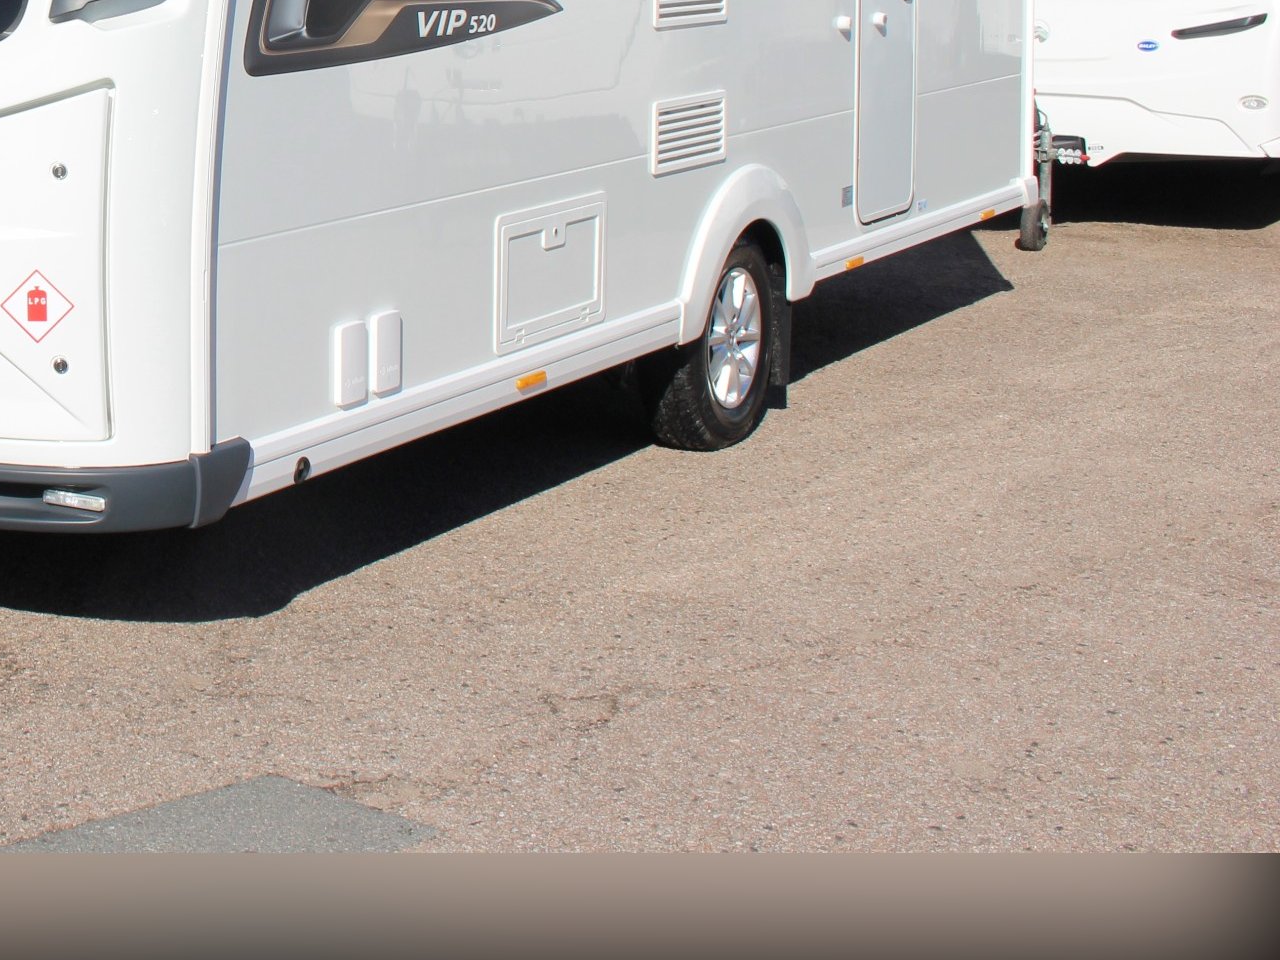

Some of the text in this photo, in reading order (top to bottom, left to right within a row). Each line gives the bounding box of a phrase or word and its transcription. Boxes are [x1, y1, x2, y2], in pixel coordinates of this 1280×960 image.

[417, 9, 497, 38] VIP 520
[28, 297, 46, 305] LPG
